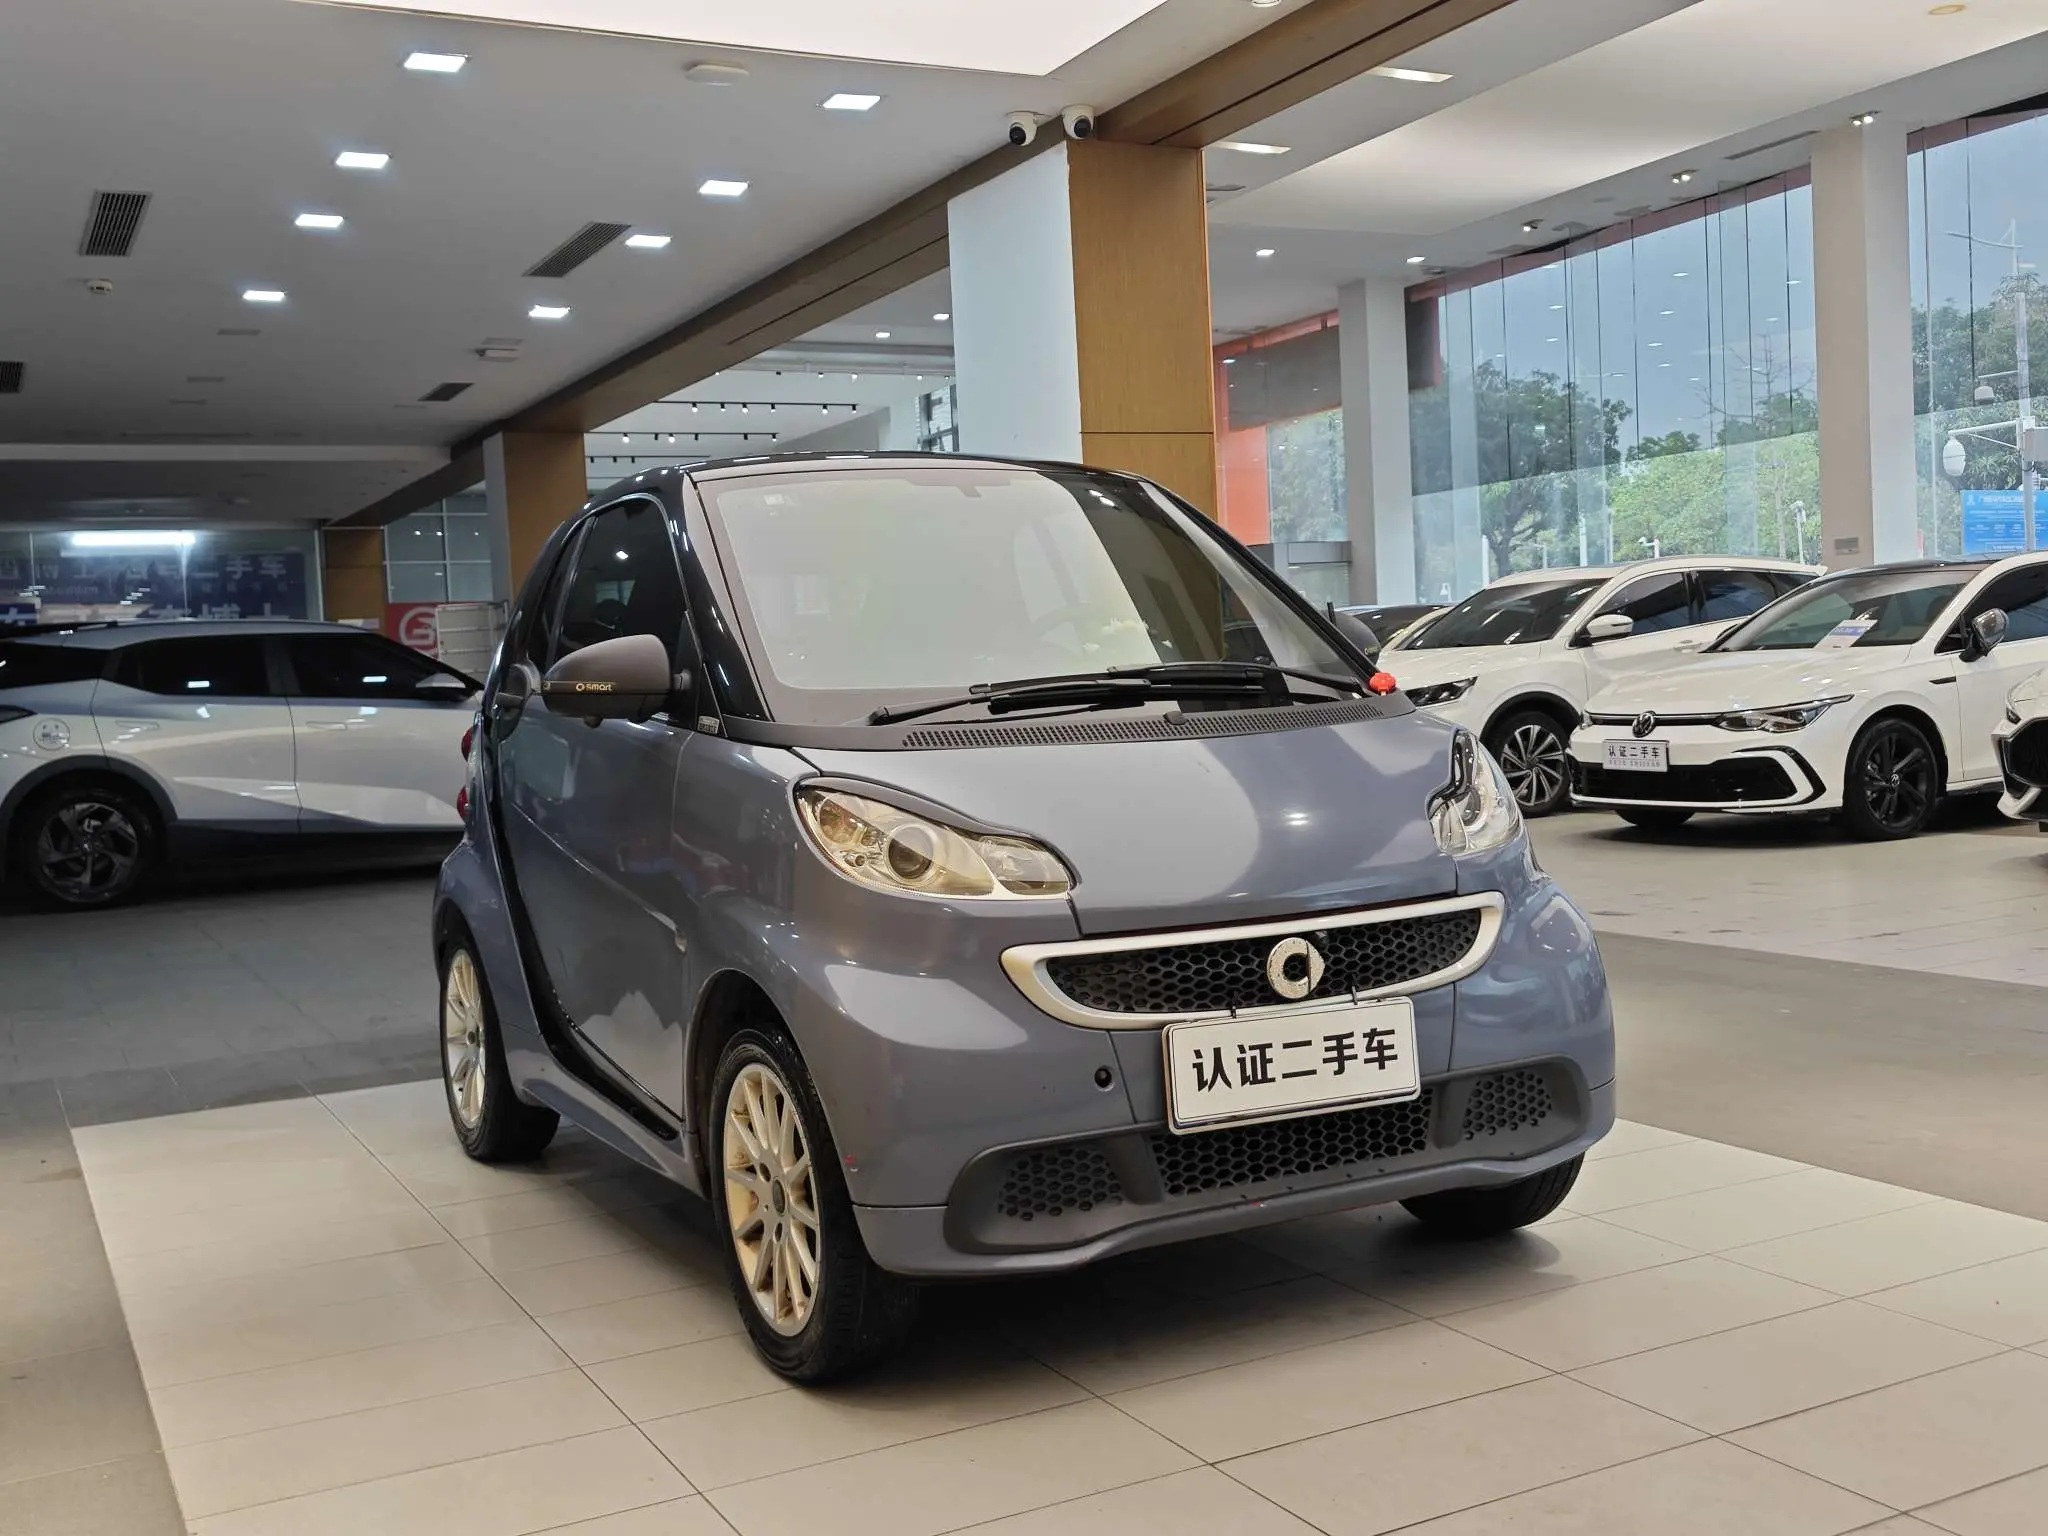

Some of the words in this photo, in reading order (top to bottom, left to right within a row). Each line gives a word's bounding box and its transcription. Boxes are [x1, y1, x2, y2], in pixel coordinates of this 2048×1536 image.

[586, 683, 612, 692] smart
[1608, 745, 1660, 759] 认证二手车
[1192, 1028, 1398, 1092] 认证二手车
